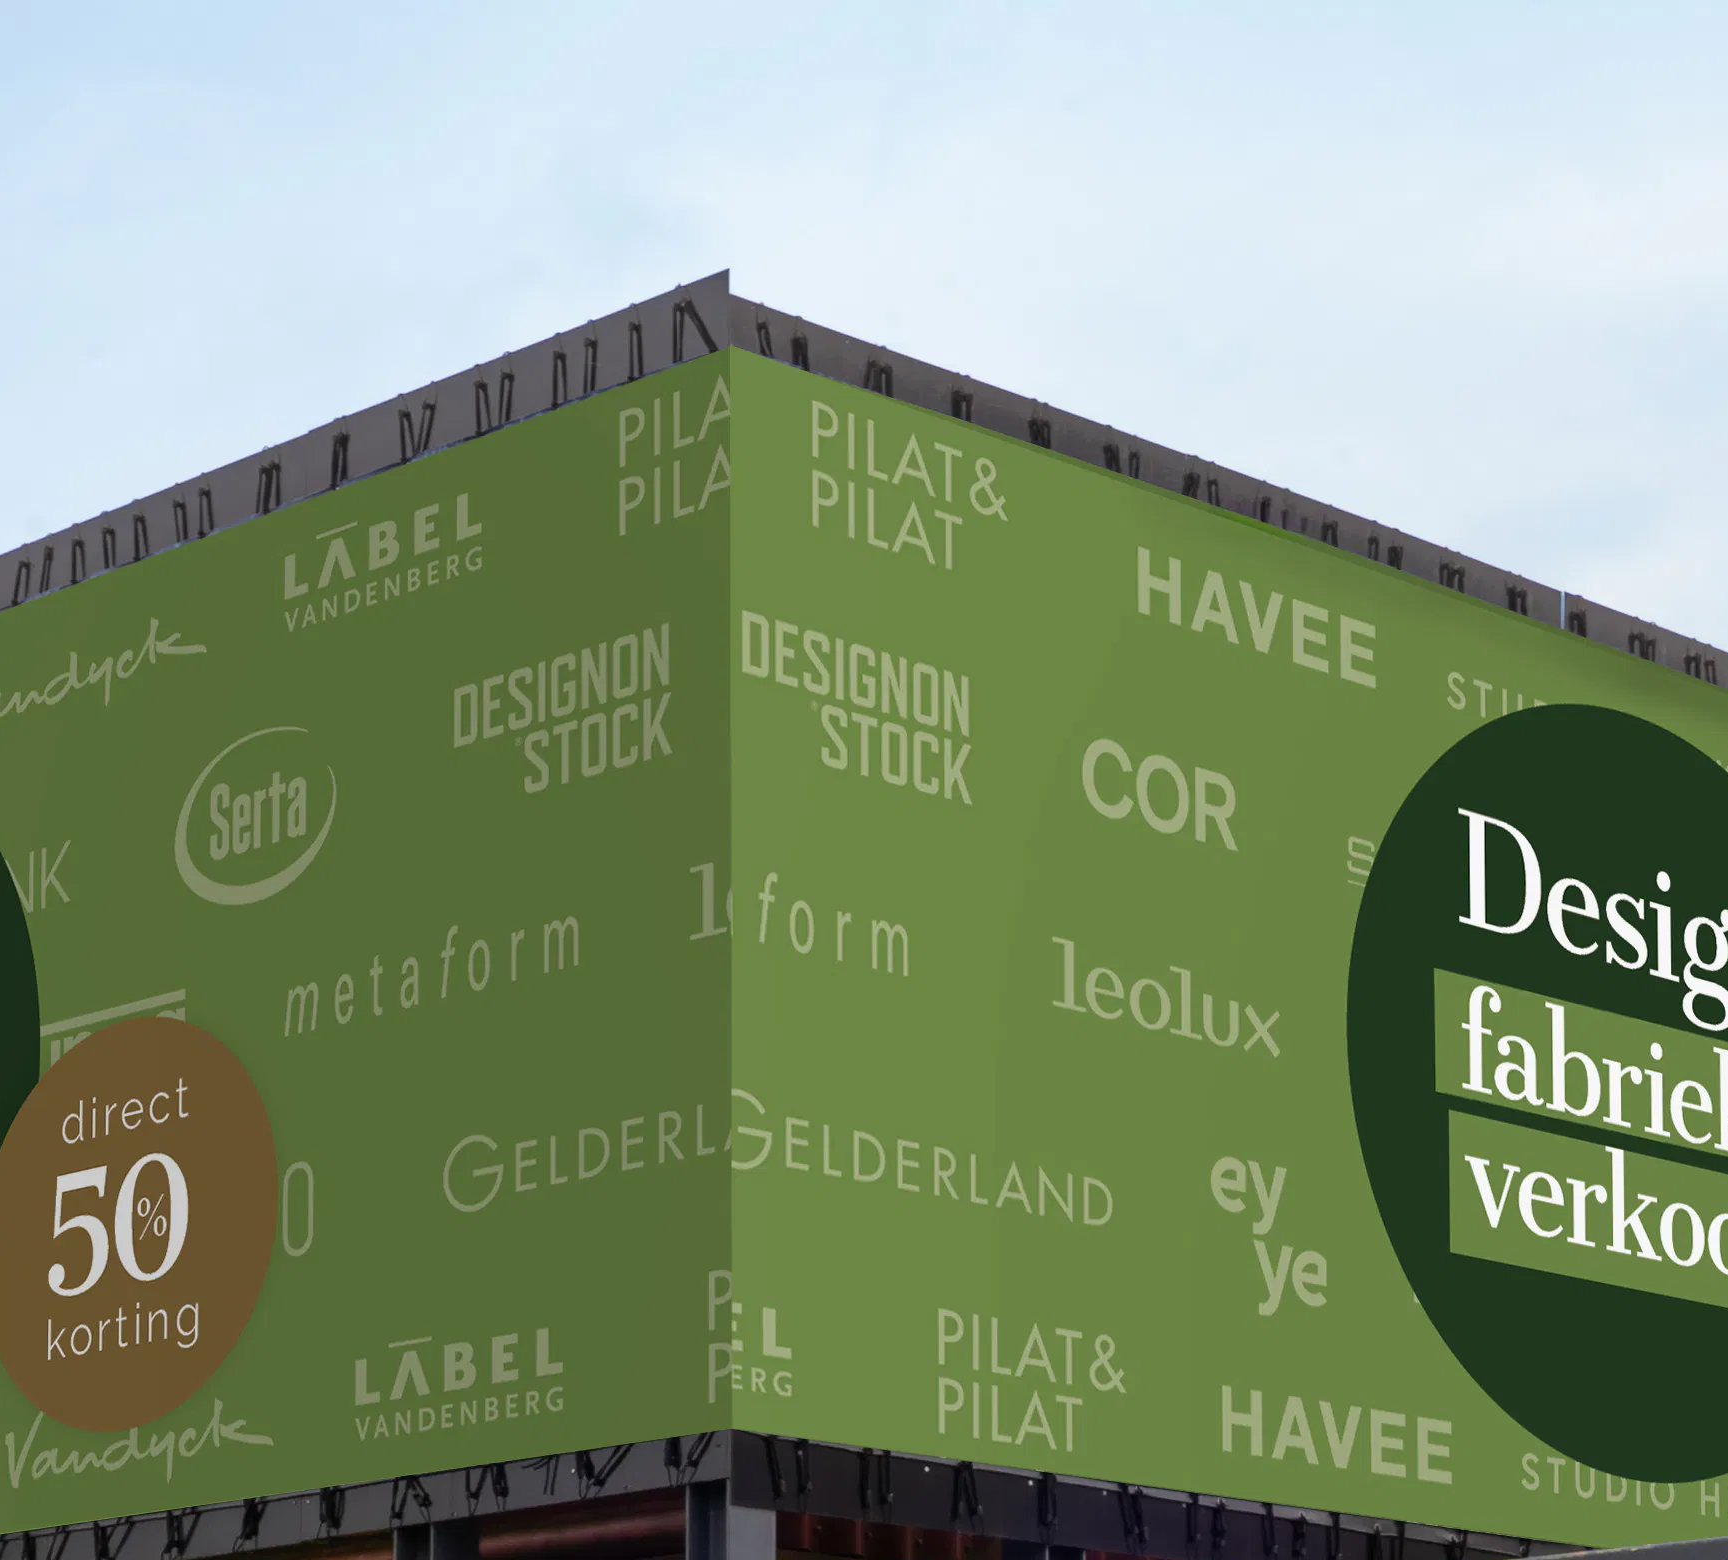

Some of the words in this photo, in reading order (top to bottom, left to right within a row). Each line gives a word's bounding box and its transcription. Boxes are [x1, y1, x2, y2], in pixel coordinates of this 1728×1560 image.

[812, 399, 1009, 522] PILAT&
[812, 470, 962, 571] PILAT
[284, 546, 483, 632] VANDENBERG
[1137, 545, 1376, 689] HAVEE
[453, 623, 671, 749] DESIGNON
[741, 610, 971, 737] DESIGNON
[524, 693, 673, 793] STOCK
[821, 703, 973, 806] STOCK
[209, 773, 307, 862] Serta
[1082, 738, 1238, 851] COR
[283, 915, 582, 1037] metaform
[1052, 937, 1281, 1057] leolux
[62, 1078, 190, 1145] direct
[731, 1088, 1113, 1227] GELDERLAND
[1210, 1155, 1287, 1234] ey
[1253, 1241, 1327, 1316] ye
[46, 1301, 201, 1362] korting
[938, 1308, 1127, 1394] PILAT&
[5, 1397, 273, 1488] Vandyck
[355, 1387, 564, 1440] VANDENBERG
[938, 1377, 1082, 1452] PILAT
[1222, 1385, 1453, 1485] HAVEE
[1522, 1453, 1674, 1510] STUDIO
